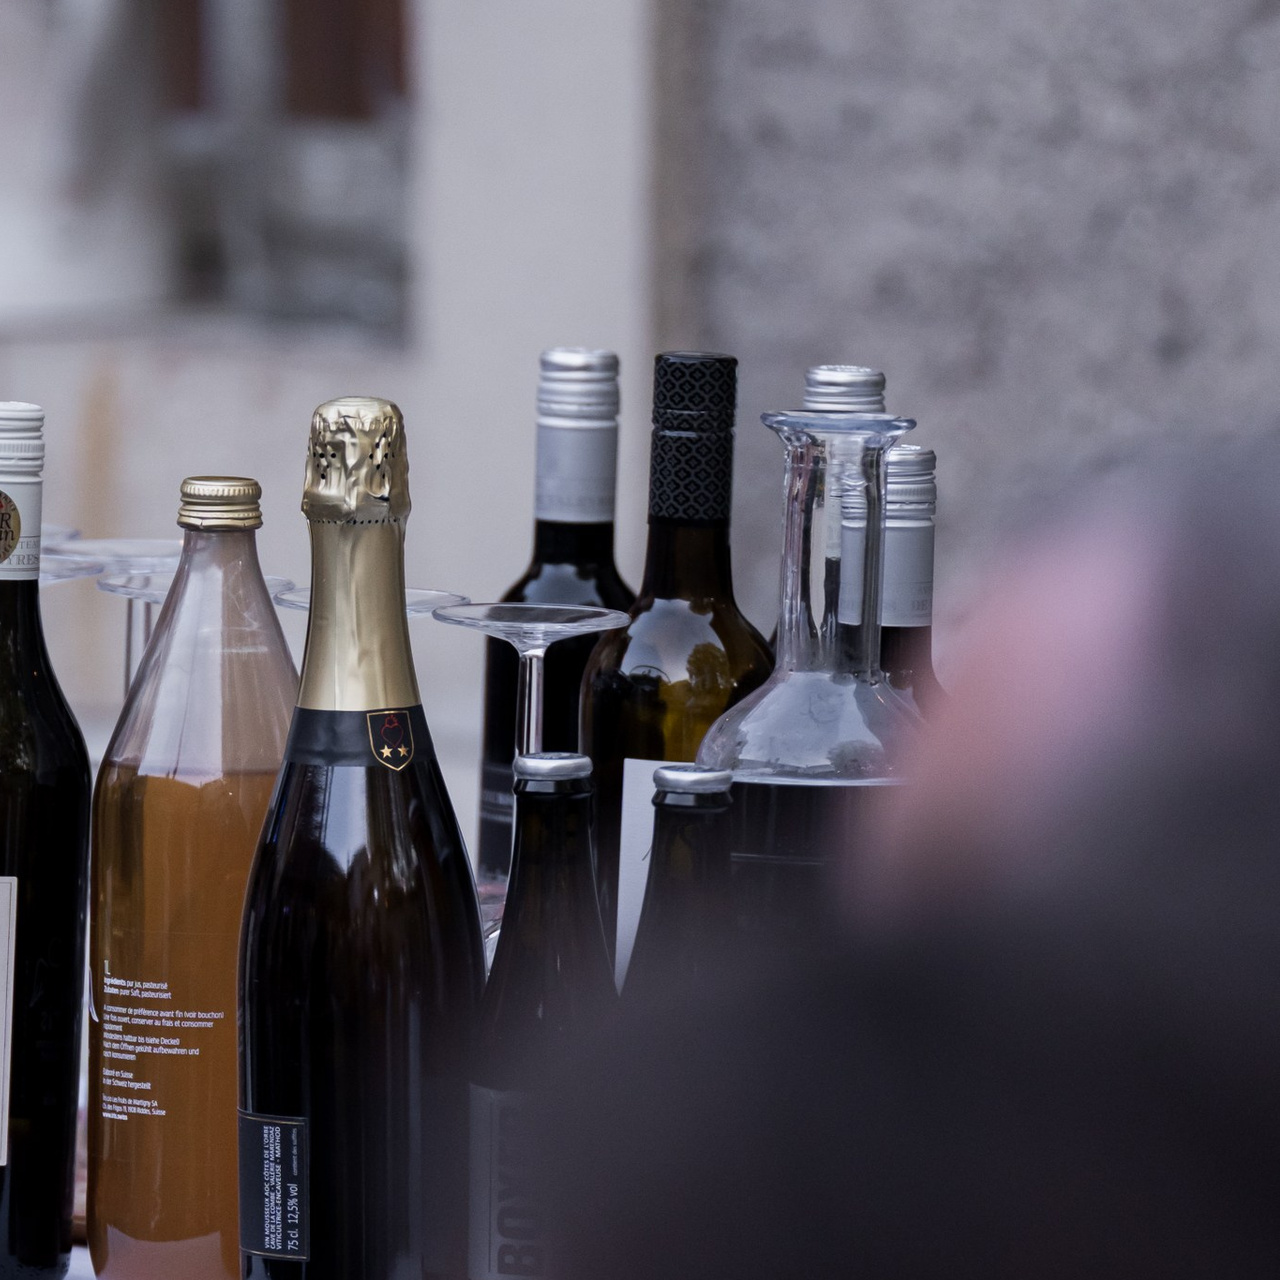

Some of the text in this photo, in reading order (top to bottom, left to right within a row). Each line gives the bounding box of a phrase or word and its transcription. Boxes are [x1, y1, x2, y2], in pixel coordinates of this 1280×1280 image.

[142, 981, 168, 990] pasteurisé
[131, 988, 141, 998] Saft,
[141, 990, 172, 1000] pasteurisiert
[133, 1008, 159, 1017] préférence
[160, 1010, 174, 1018] avant
[175, 1009, 183, 1019] fin
[183, 1010, 197, 1019] (voir
[198, 1010, 225, 1019] bouchon)
[131, 1016, 153, 1025] conserver
[161, 1018, 174, 1027] frais
[174, 1019, 181, 1027] et
[181, 1020, 214, 1028] consommer
[160, 1036, 180, 1045] Deckel)
[153, 1045, 187, 1055] aufbewahren
[188, 1047, 199, 1055] und
[120, 1070, 133, 1079] Suisse
[128, 1078, 151, 1090] hergestellt
[151, 1099, 158, 1107] SA
[151, 1107, 166, 1116] Suisse
[264, 1149, 269, 1158] DE
[287, 1183, 300, 1251] 75 cl. 12,5% vol
